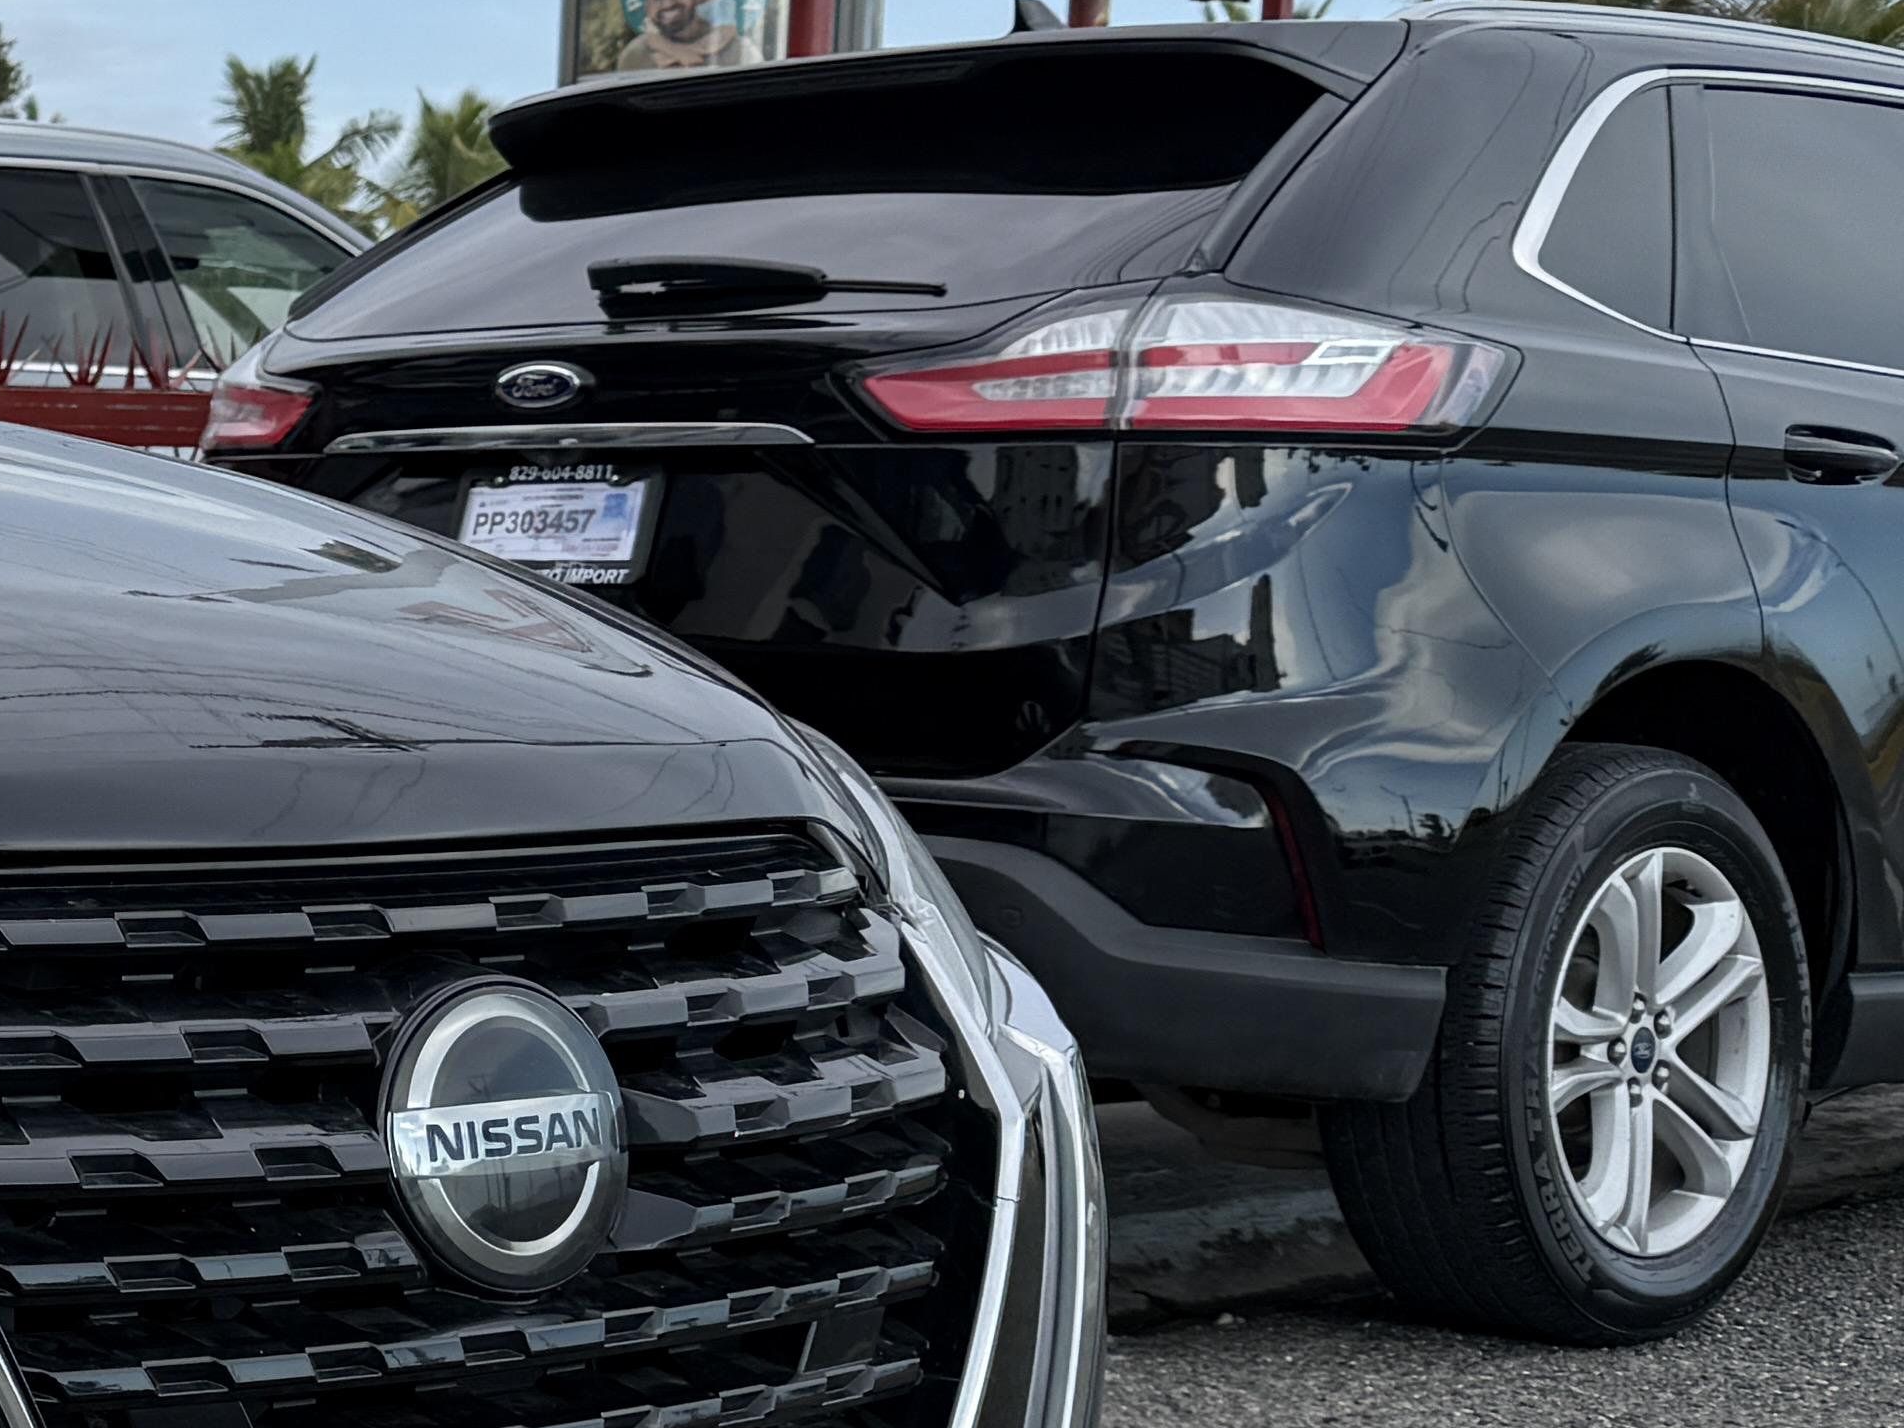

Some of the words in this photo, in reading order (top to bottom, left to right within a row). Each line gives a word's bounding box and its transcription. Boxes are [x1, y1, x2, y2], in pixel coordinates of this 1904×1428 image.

[508, 464, 614, 481] 829-604-8811
[473, 509, 596, 536] PP303457
[425, 1108, 601, 1163] NISSAN
[1533, 1150, 1595, 1283] TERRA
